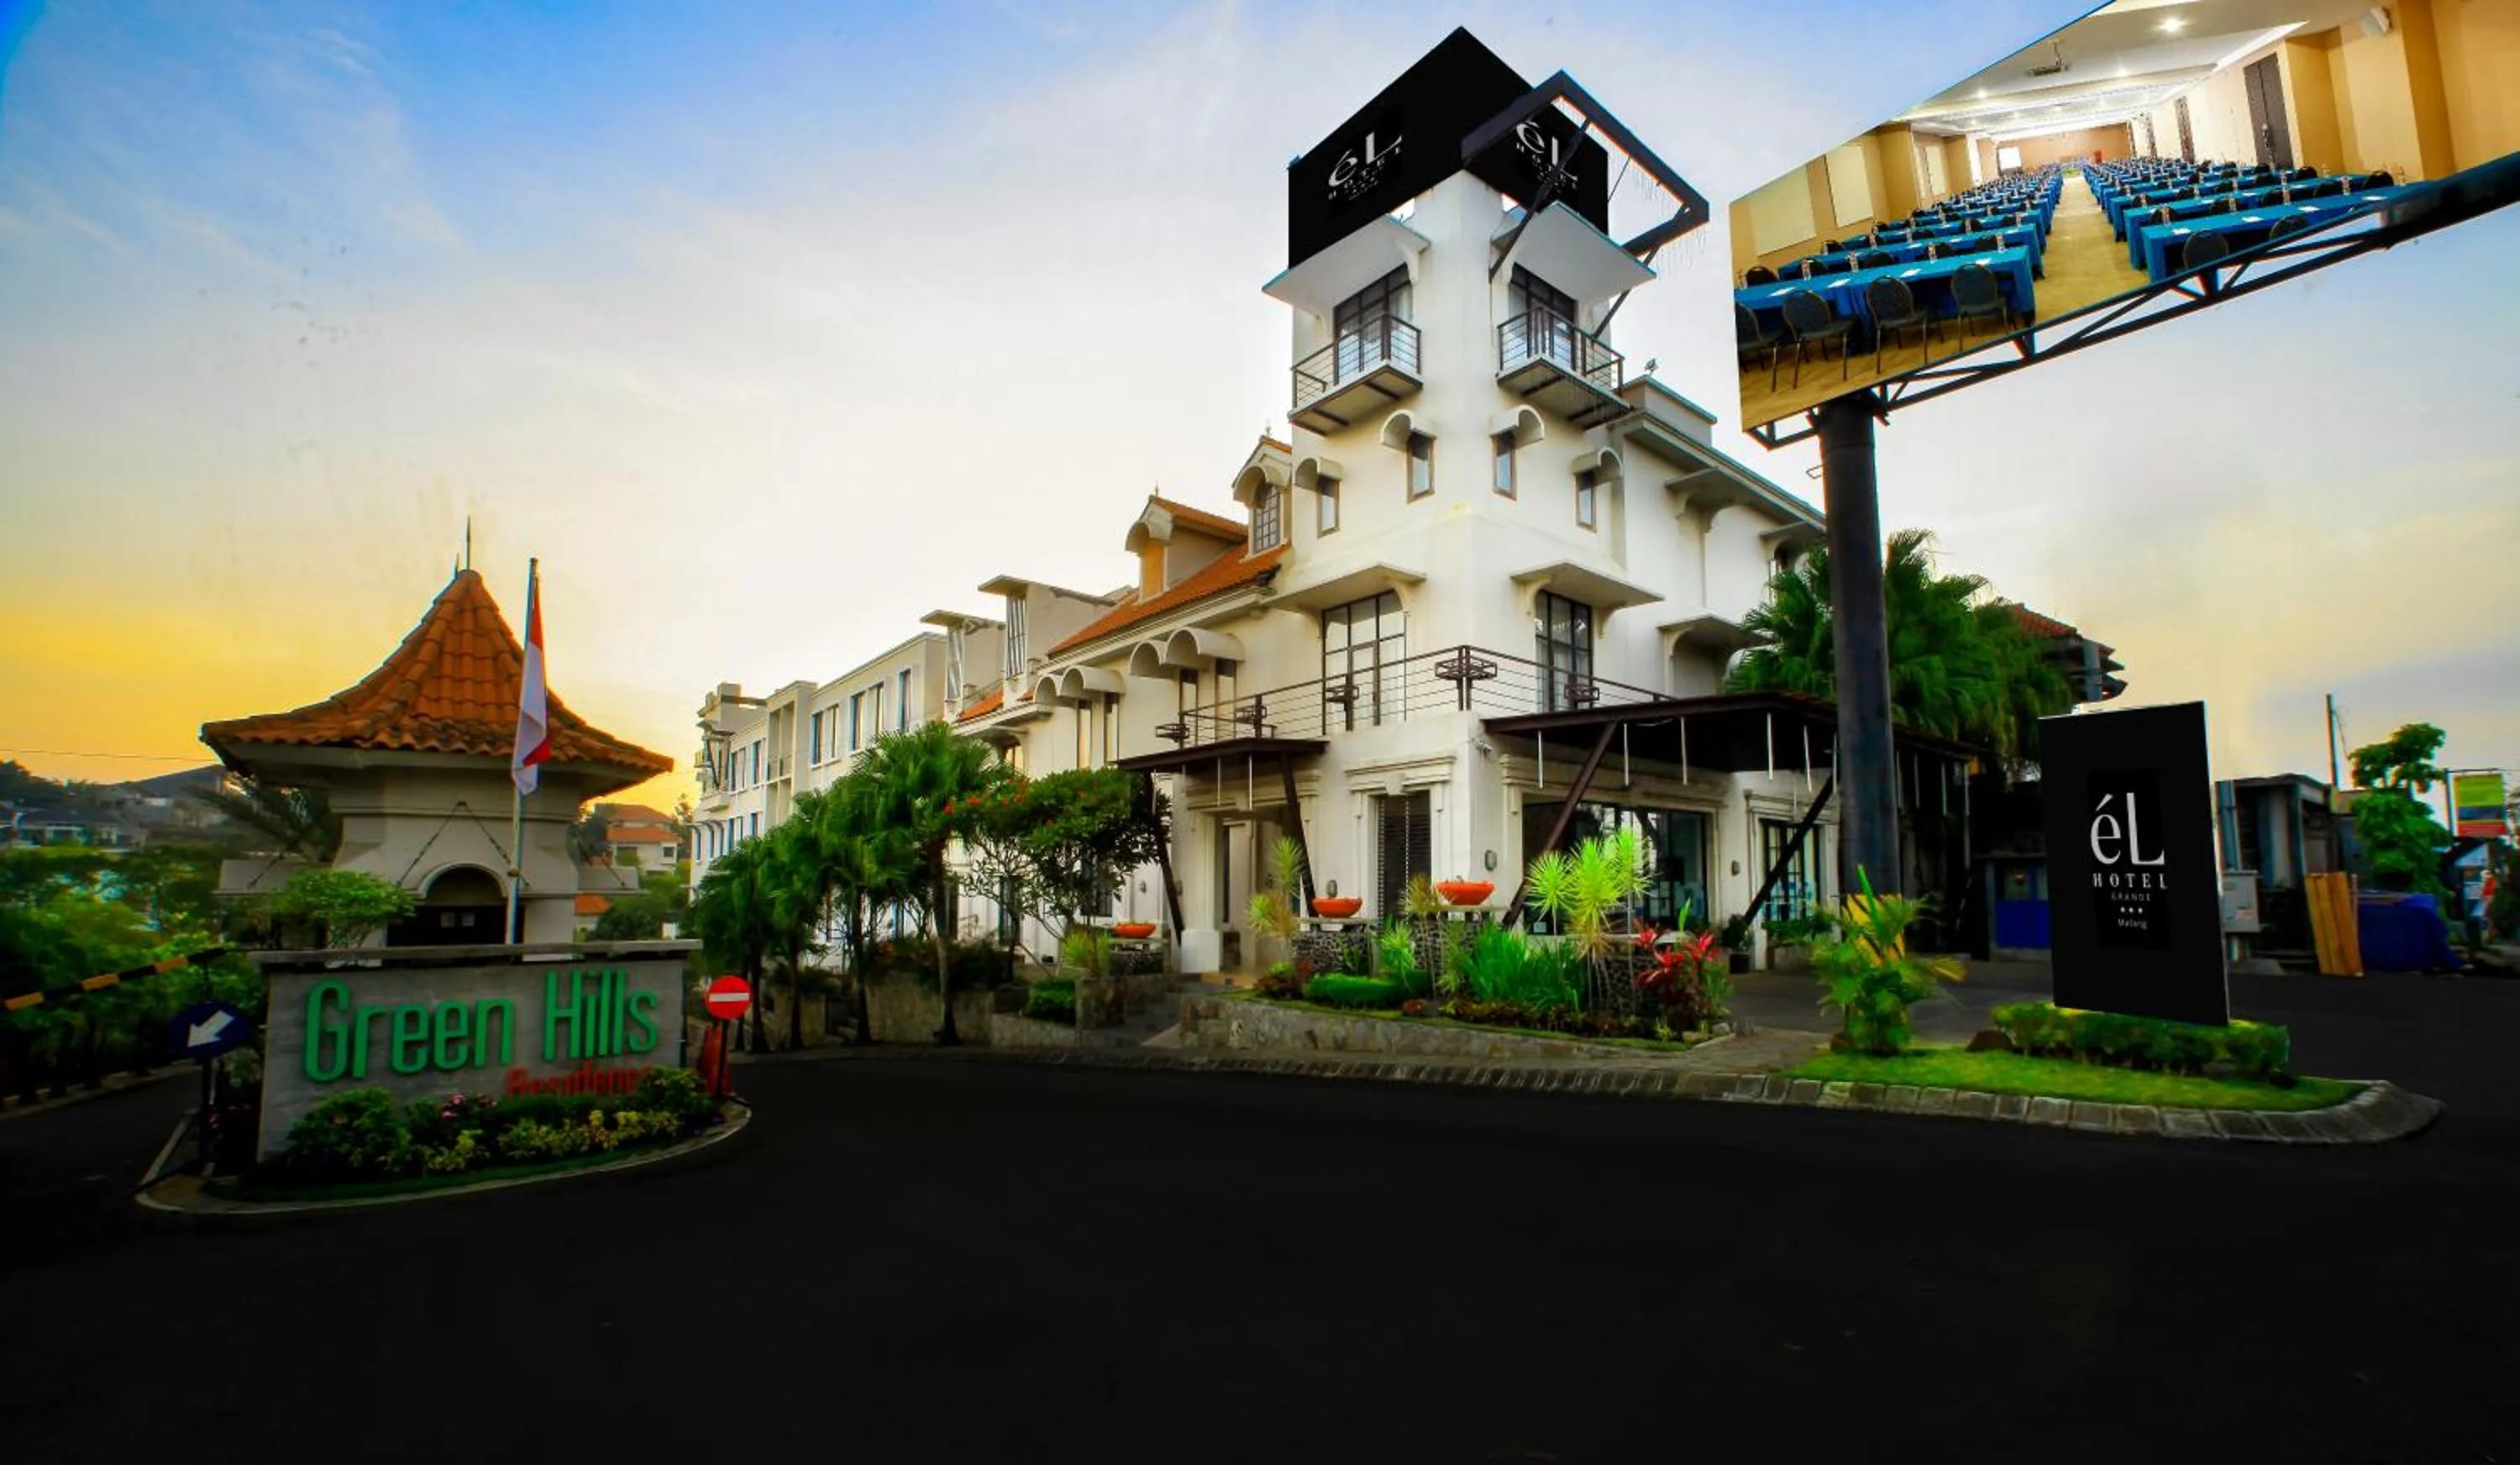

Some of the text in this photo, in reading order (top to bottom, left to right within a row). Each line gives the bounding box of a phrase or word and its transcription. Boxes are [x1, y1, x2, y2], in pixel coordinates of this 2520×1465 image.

[1328, 130, 1403, 186] éL
[2090, 791, 2165, 865] éL
[2092, 872, 2168, 890] HOTEL
[304, 967, 659, 1083] Green Hills
